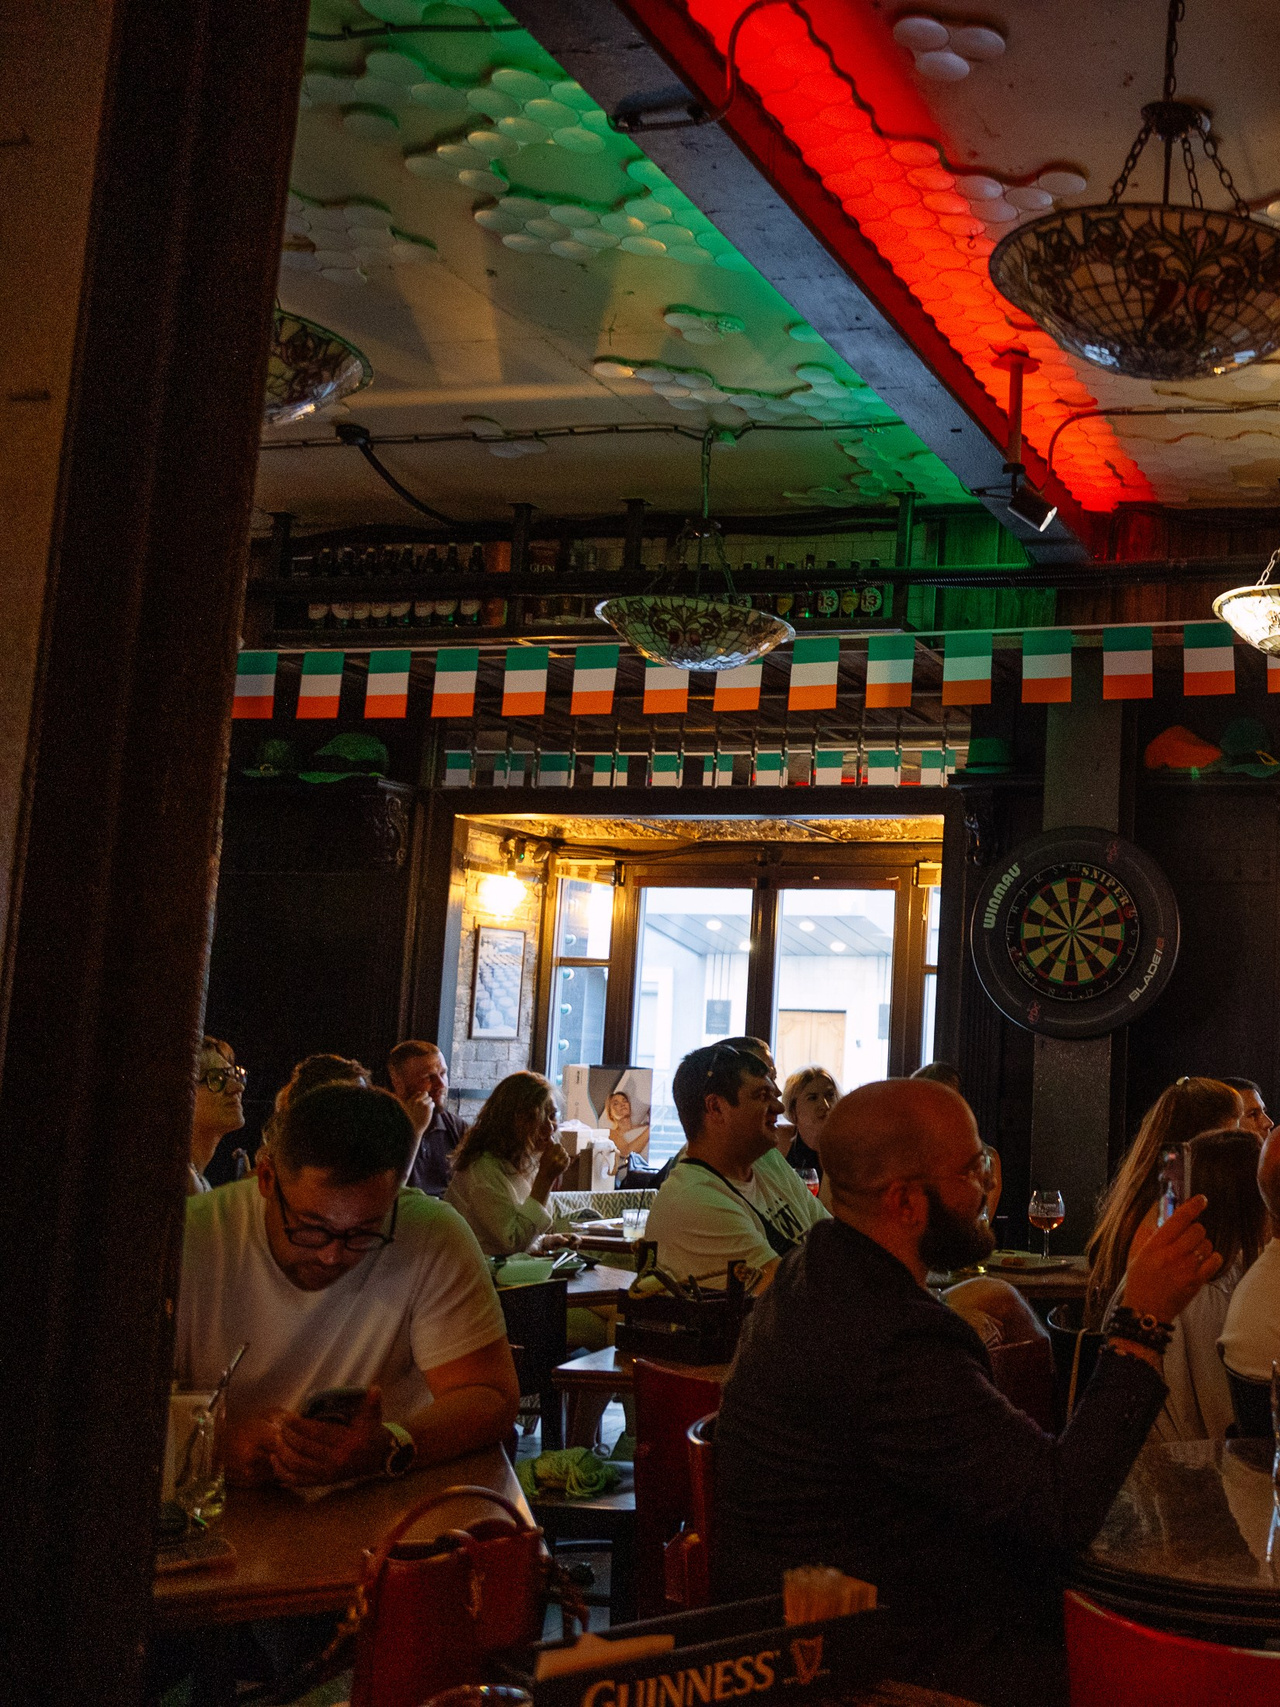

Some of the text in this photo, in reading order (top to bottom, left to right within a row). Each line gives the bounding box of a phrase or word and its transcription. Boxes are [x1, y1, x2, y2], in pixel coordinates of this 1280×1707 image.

[983, 862, 1021, 929] WINMAU
[1081, 866, 1129, 906] SNIPER
[1128, 952, 1163, 1002] BLADE
